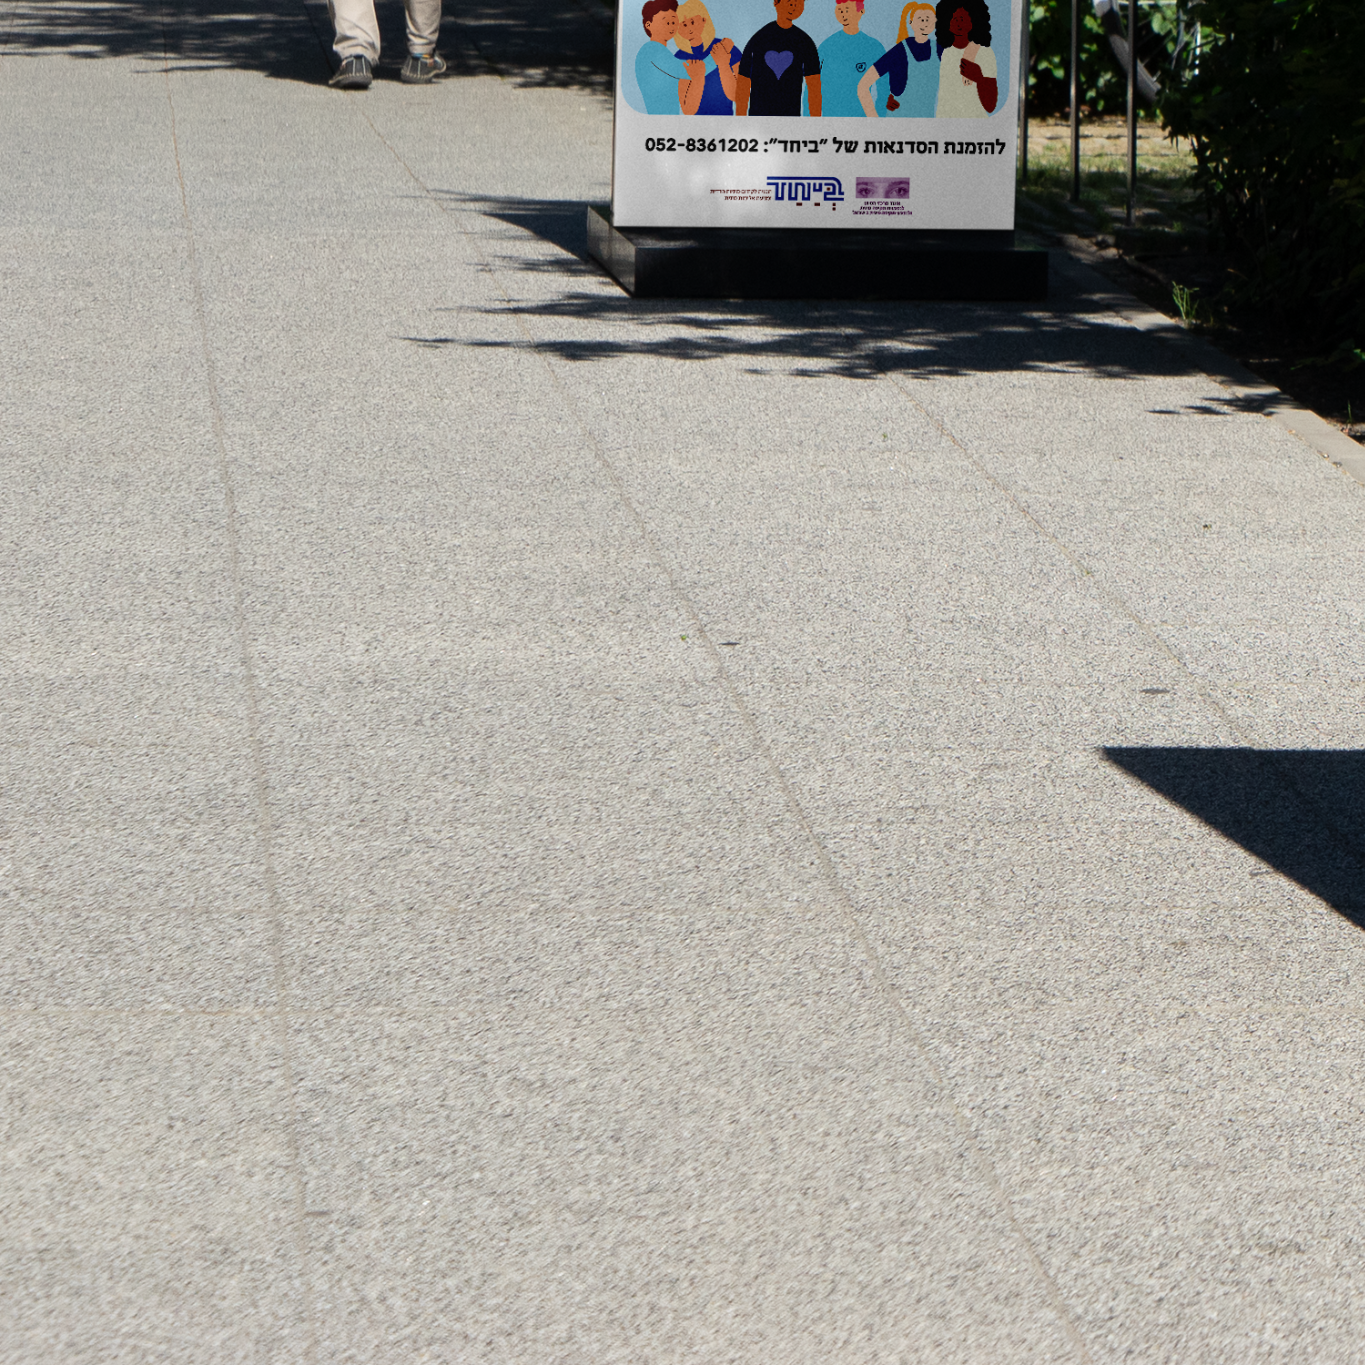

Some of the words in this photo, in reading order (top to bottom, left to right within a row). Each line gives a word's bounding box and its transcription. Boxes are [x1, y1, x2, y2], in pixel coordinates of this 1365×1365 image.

[645, 137, 758, 152] 052-8361202
[832, 136, 858, 153] של
[863, 140, 939, 154] הסדנאות
[943, 138, 1006, 155] להזמנת
